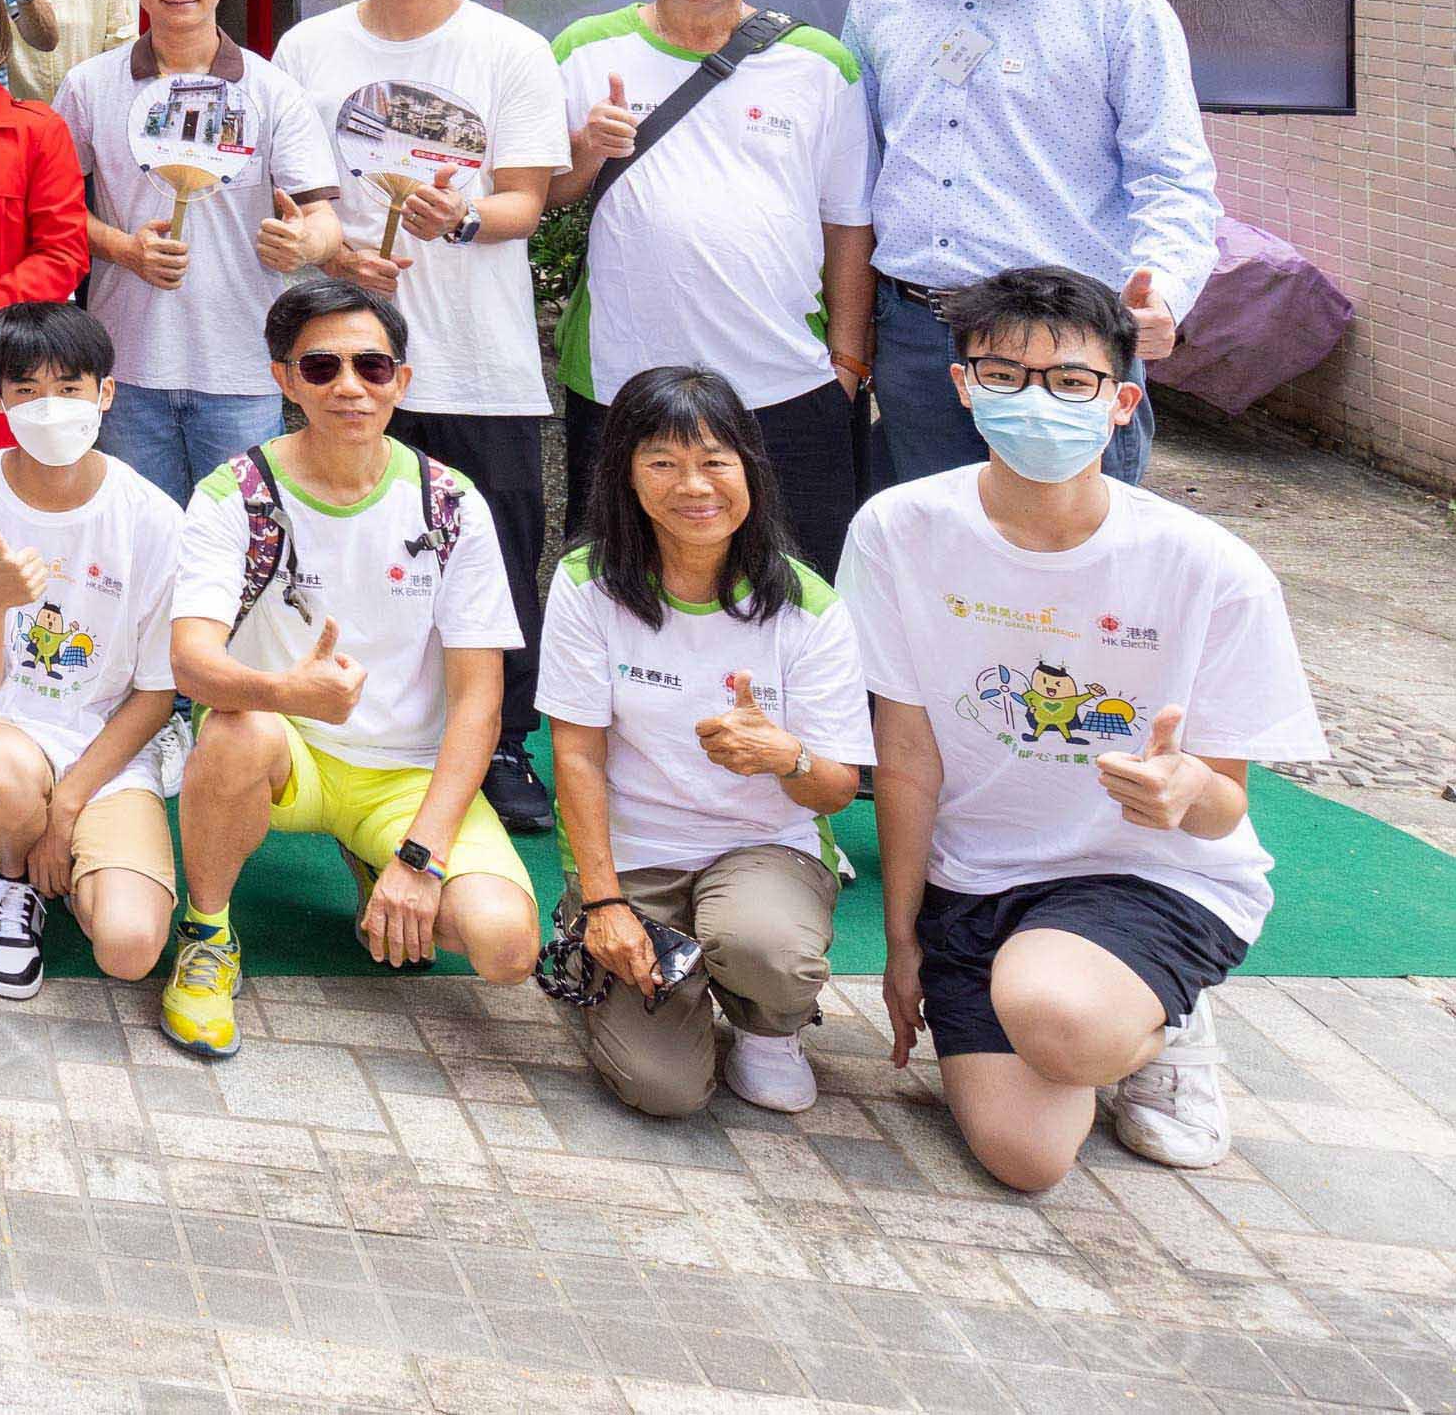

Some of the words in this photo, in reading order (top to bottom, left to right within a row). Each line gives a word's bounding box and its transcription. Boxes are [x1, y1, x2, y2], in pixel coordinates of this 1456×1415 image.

[1126, 626, 1159, 642] 港燈
[1101, 637, 1119, 648] HK
[1120, 638, 1162, 651] Electric
[630, 665, 682, 687] 長春社
